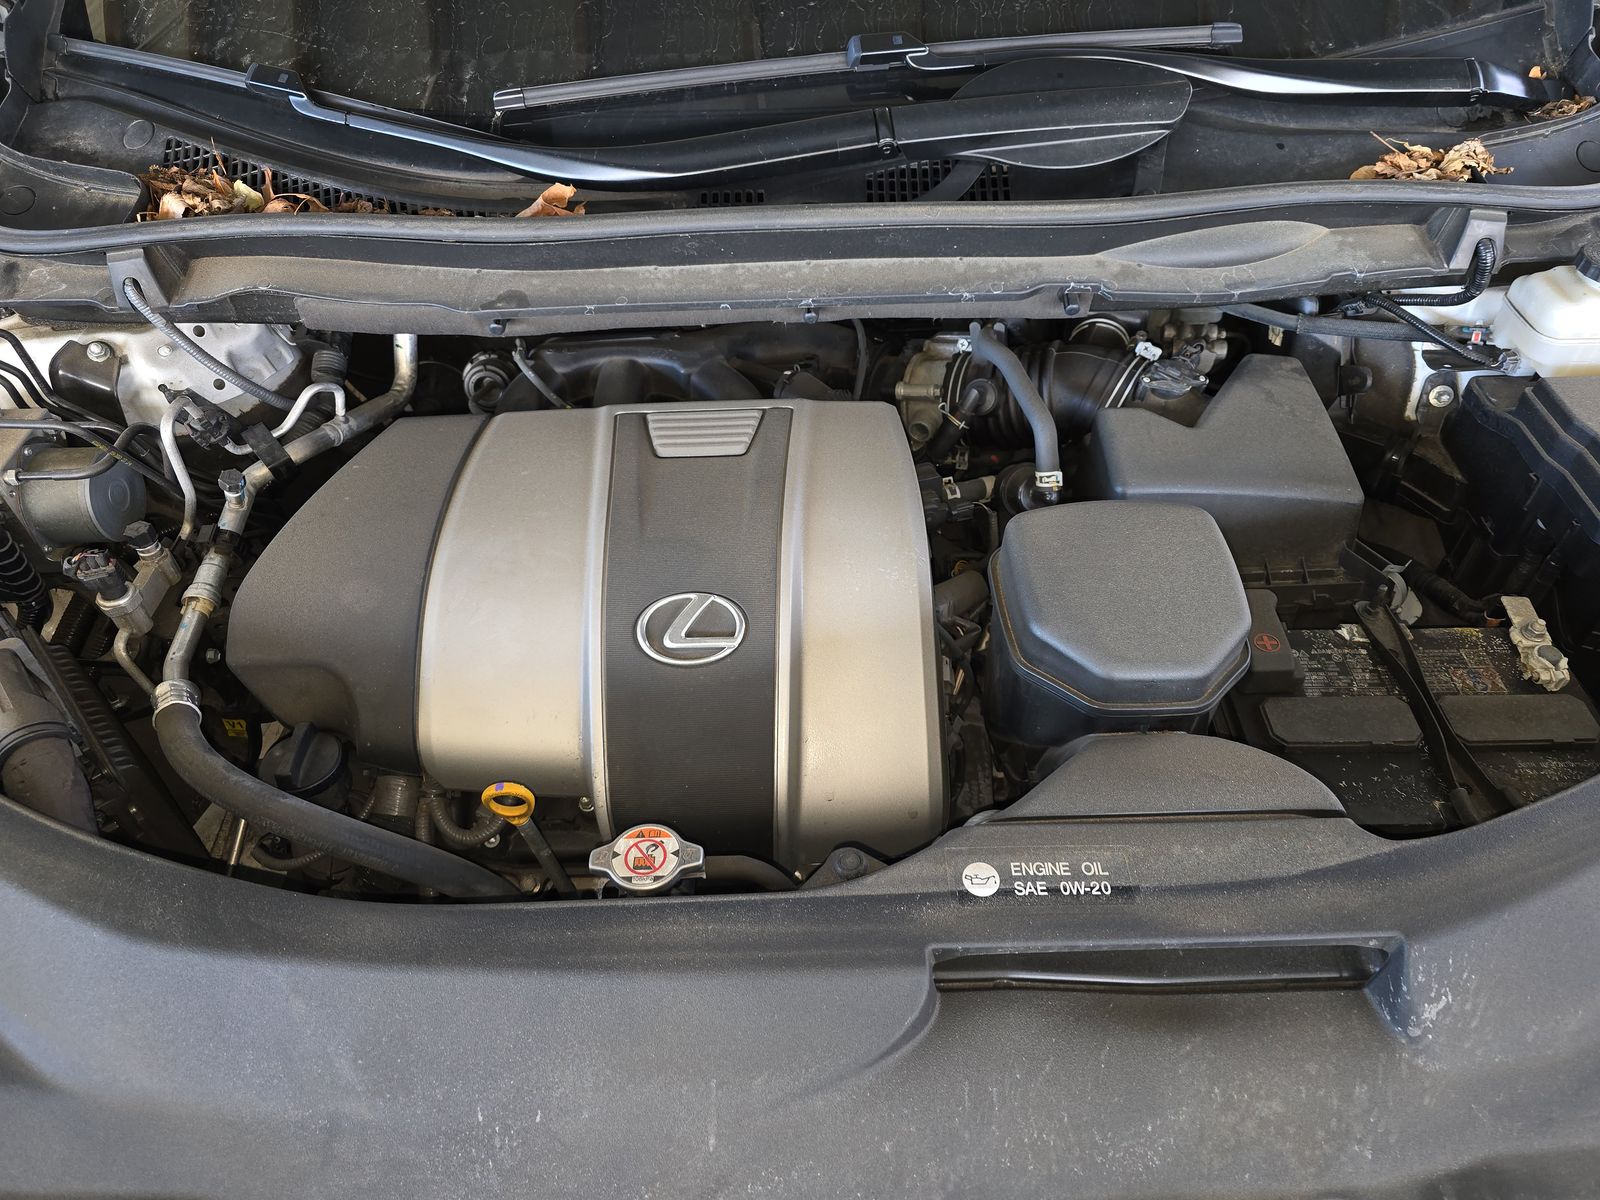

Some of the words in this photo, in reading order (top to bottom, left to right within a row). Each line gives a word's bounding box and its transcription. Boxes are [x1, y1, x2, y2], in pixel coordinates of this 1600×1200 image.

[1010, 861, 1071, 876] ENGINE
[1081, 861, 1109, 876] OIL
[1014, 881, 1048, 896] SAE
[1060, 881, 1111, 896] 0W-20
